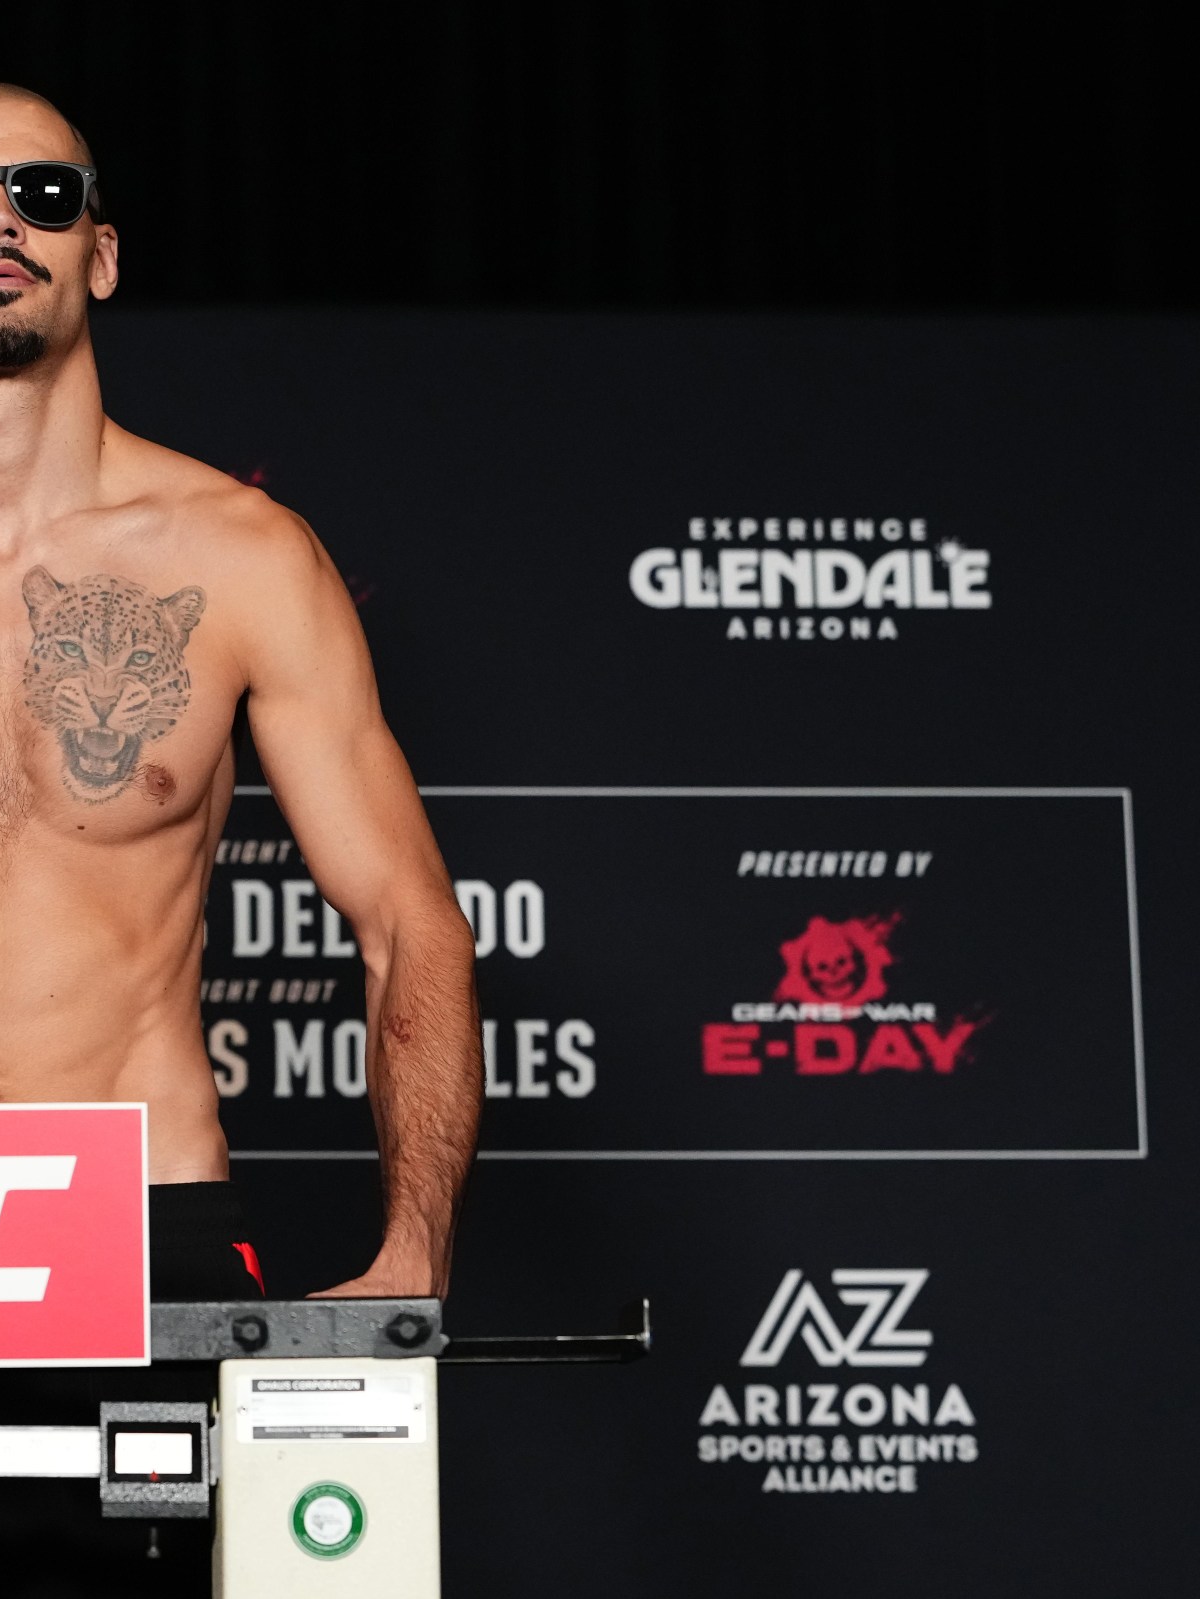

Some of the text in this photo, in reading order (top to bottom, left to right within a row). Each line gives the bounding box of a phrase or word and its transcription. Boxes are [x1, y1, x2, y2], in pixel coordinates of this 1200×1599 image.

[689, 518, 927, 541] EXPERIENCE
[629, 547, 992, 609] GLENDALE
[726, 617, 898, 640] ARIZONA
[215, 839, 292, 864] EIGHT
[737, 851, 932, 877] PRESENTED BY
[232, 879, 545, 959] DELDO
[202, 1019, 596, 1098] S MOLES
[702, 1024, 976, 1075] E-DAY
[700, 1383, 975, 1426] ARIZONA
[698, 1434, 979, 1462] SPORTS & EVENTS
[762, 1465, 917, 1493] ALLIANCE
